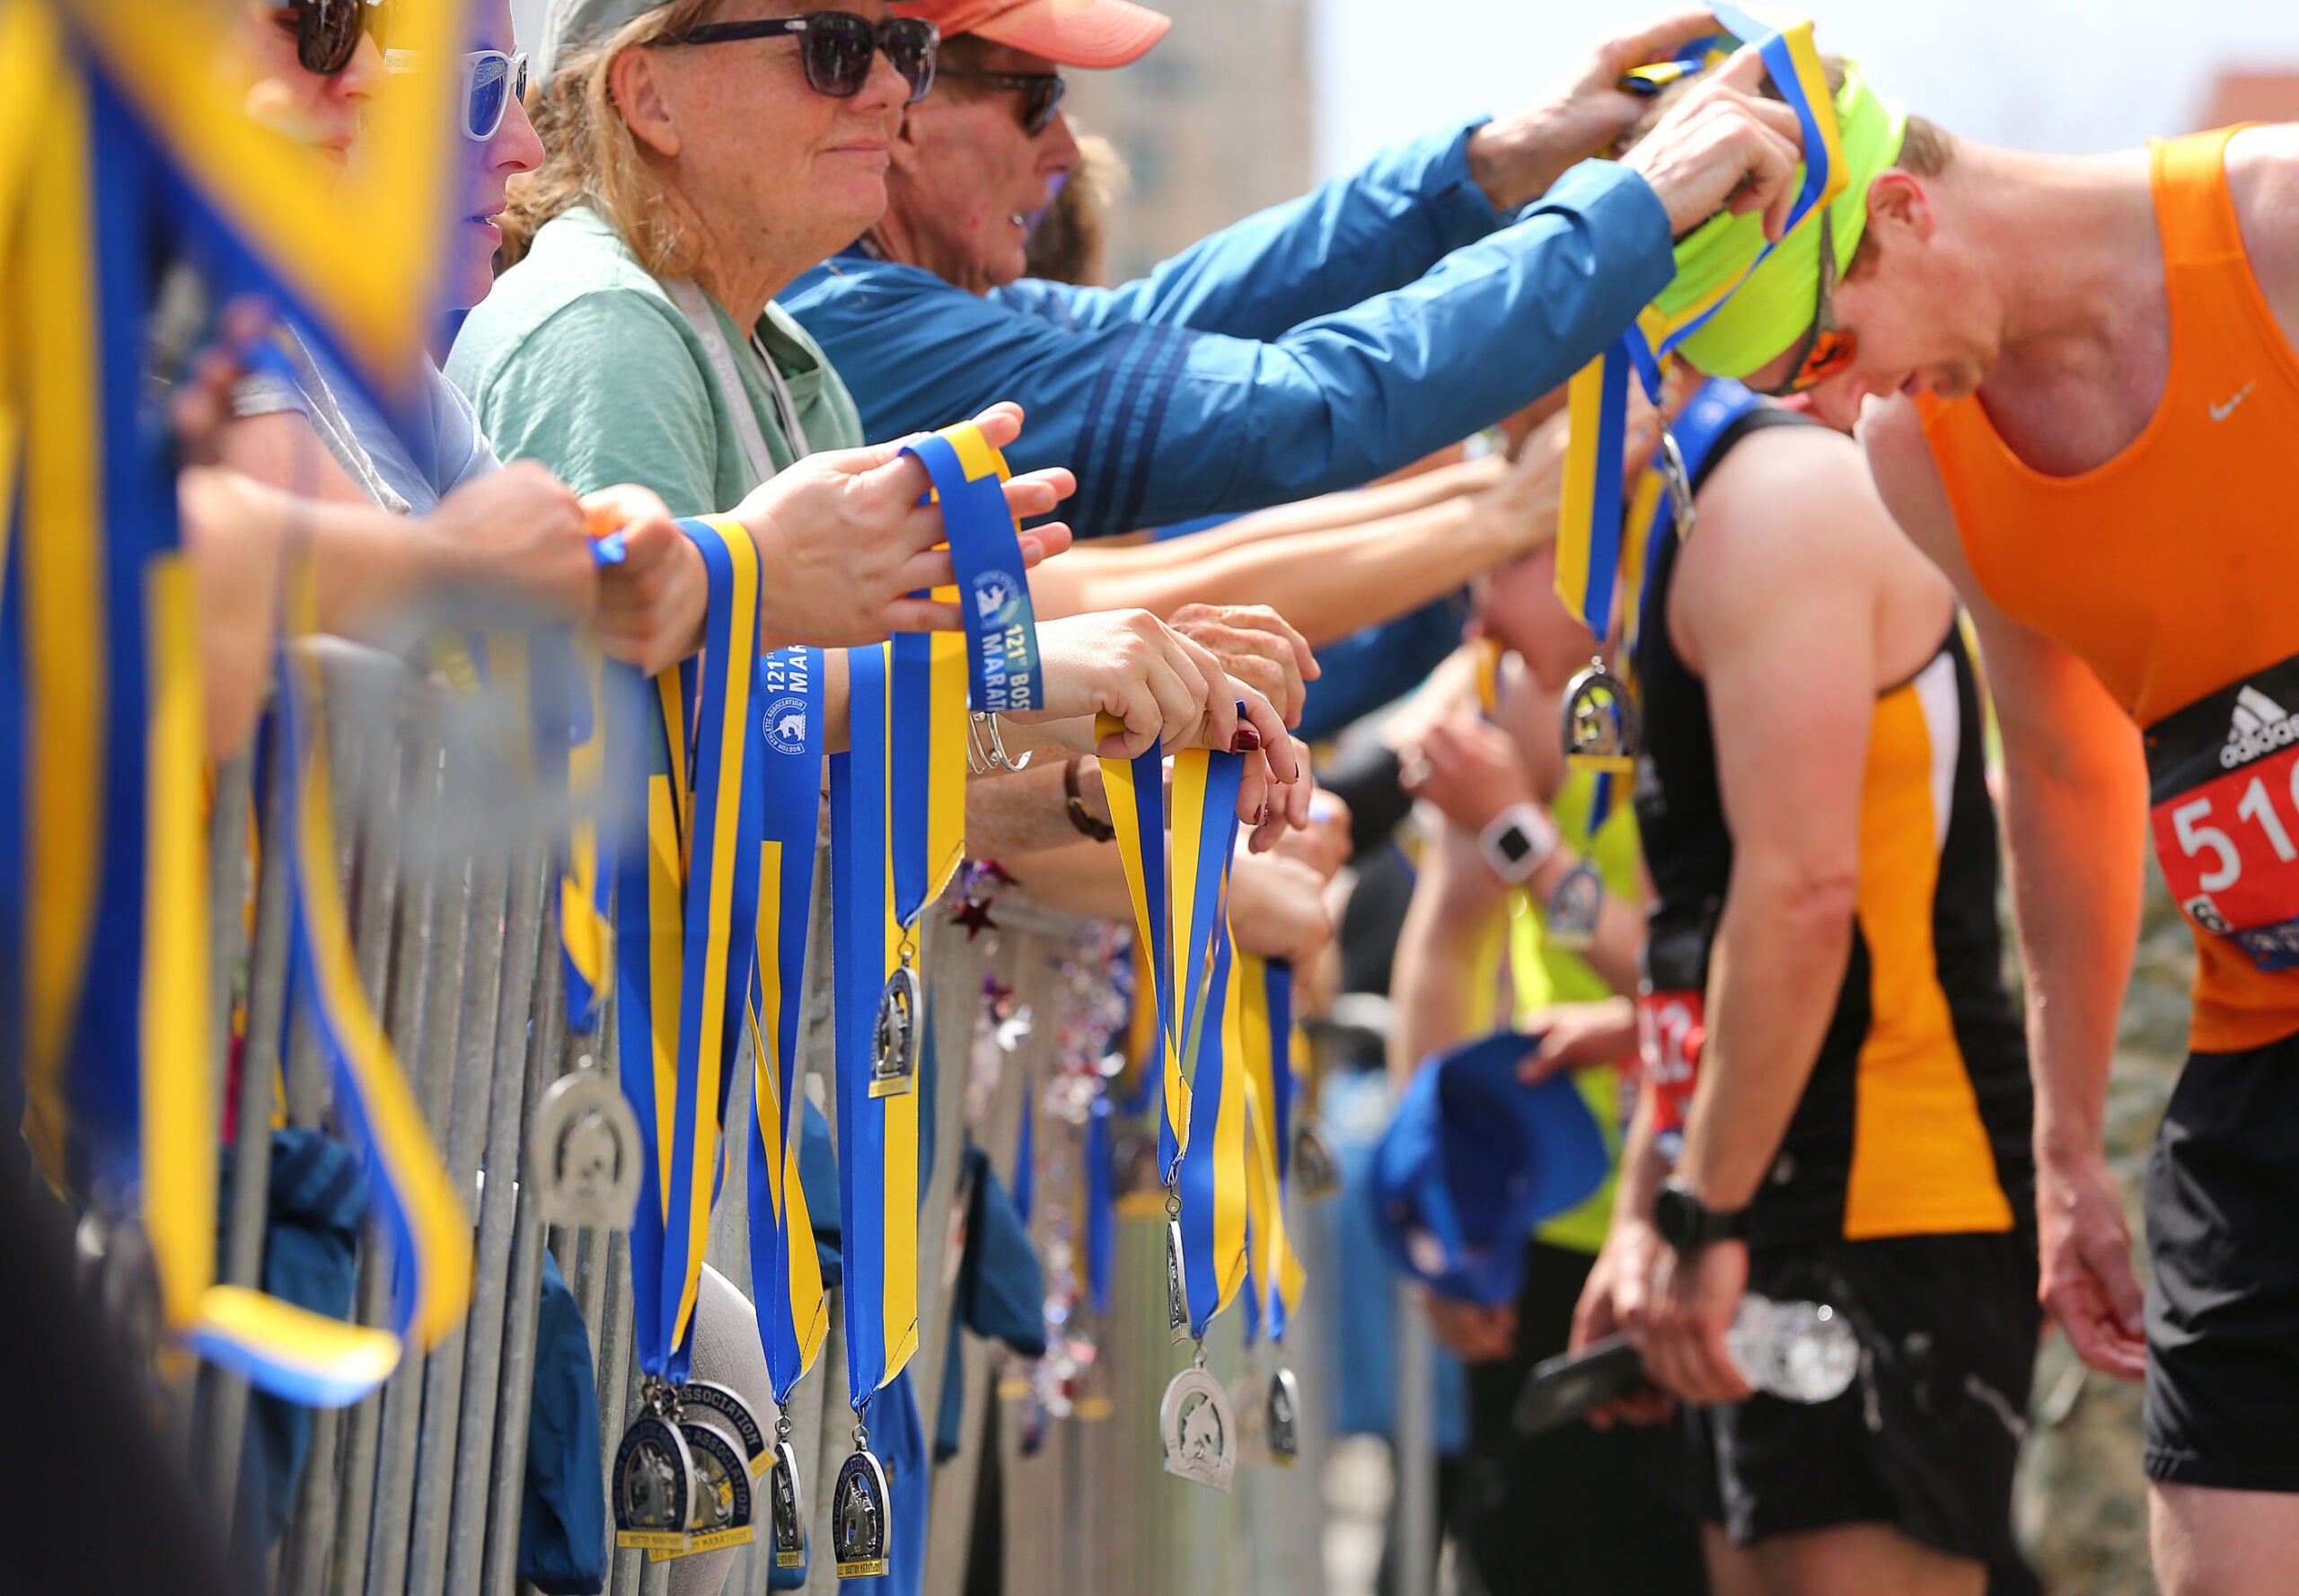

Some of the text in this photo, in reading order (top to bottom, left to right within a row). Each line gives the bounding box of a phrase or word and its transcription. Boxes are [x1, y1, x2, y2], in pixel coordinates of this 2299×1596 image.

[765, 700, 804, 753] BOSTON ATHLETIC ASSOCIATION
[2171, 760, 2299, 893] 51
[693, 1429, 749, 1516] ASSOCIATION
